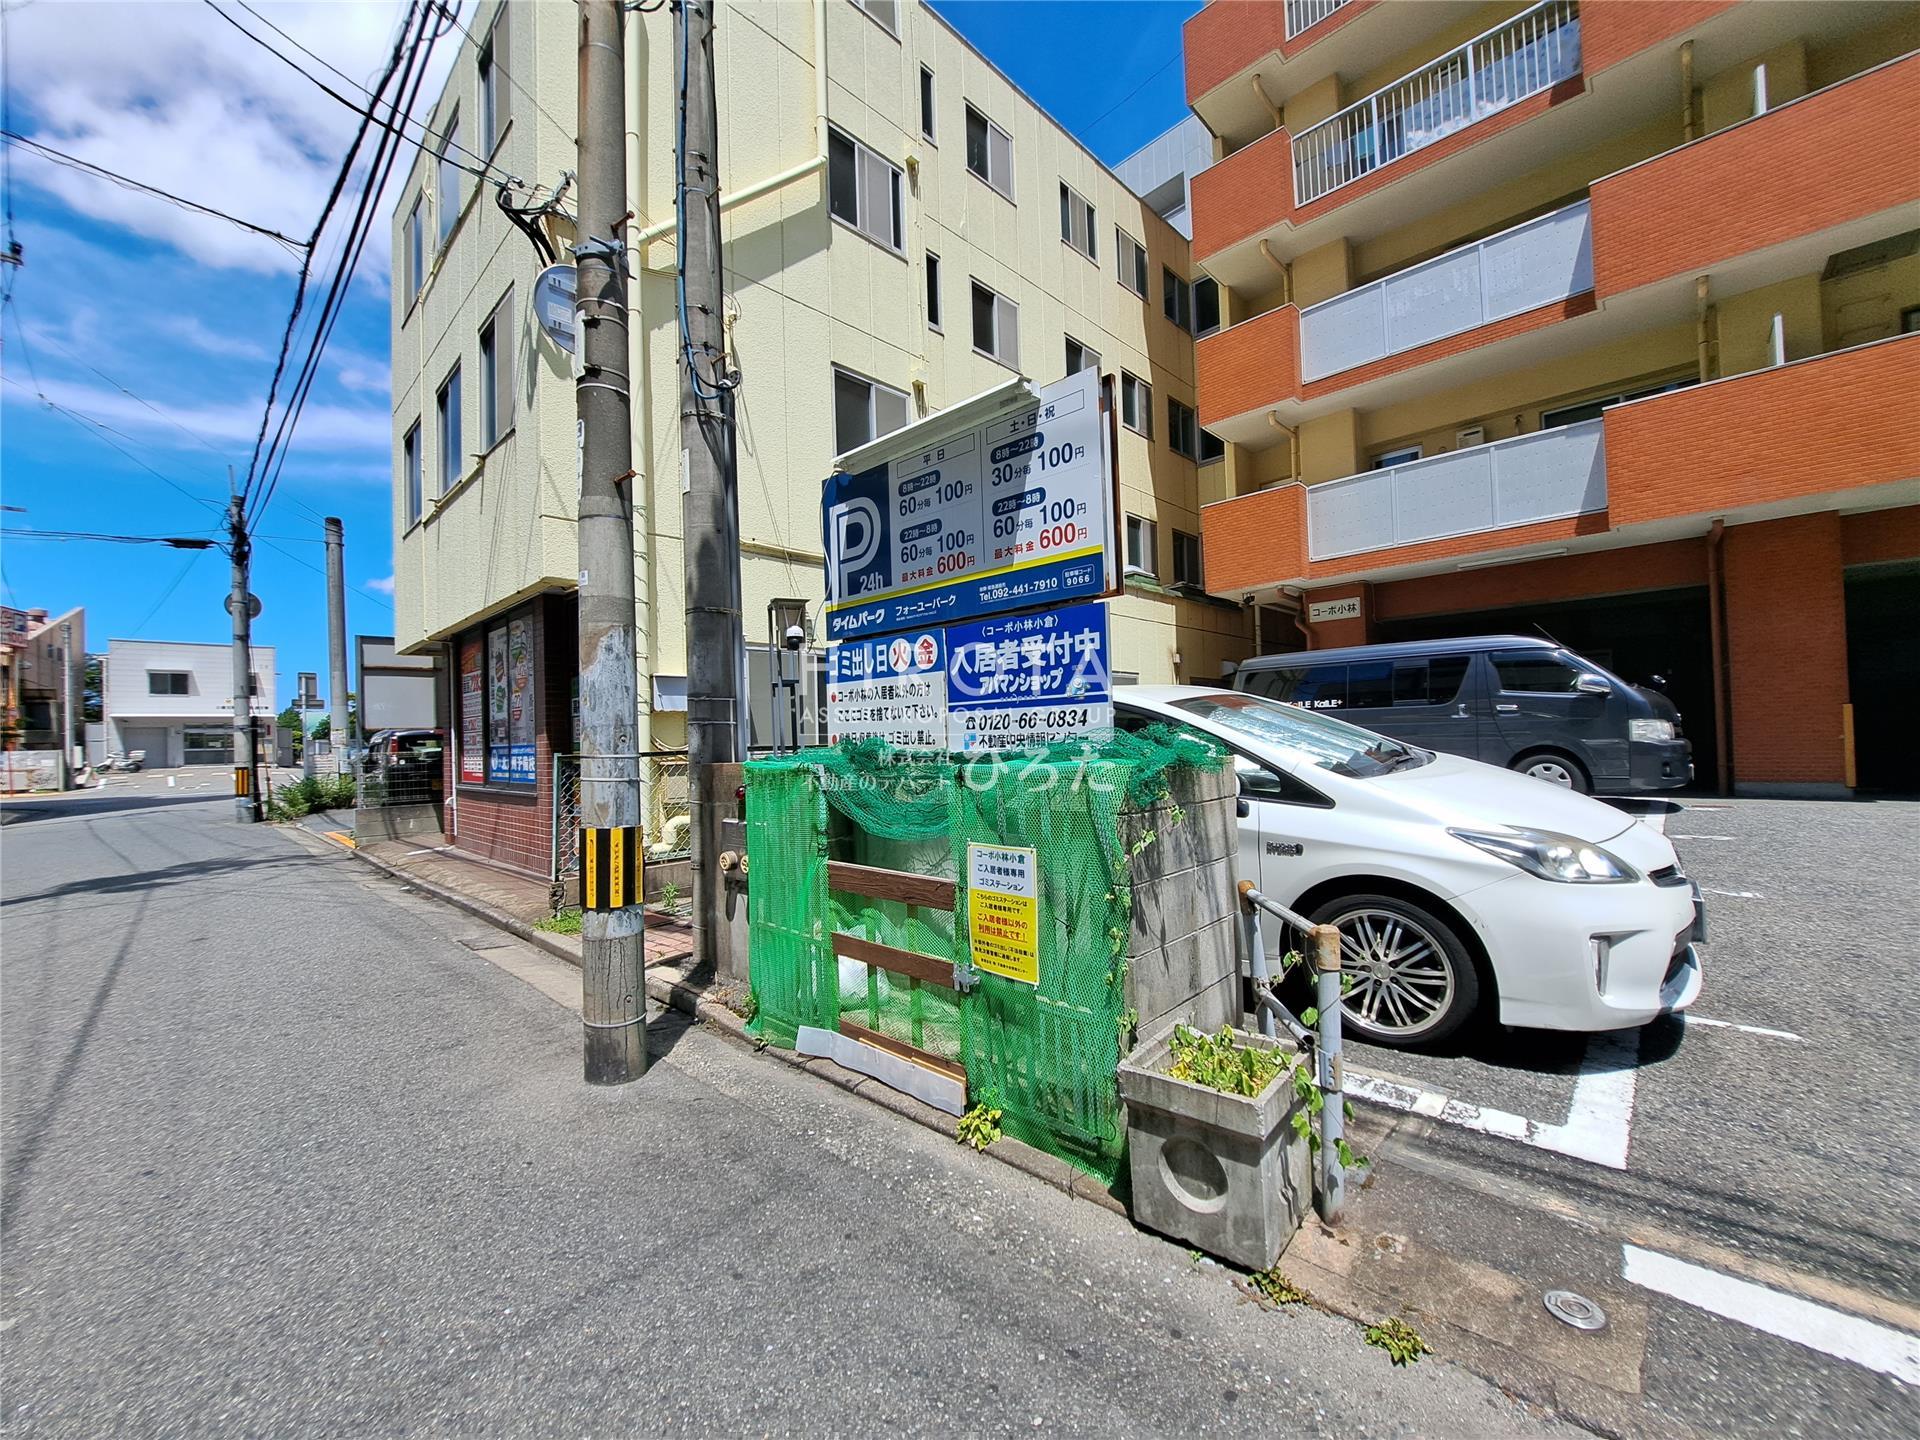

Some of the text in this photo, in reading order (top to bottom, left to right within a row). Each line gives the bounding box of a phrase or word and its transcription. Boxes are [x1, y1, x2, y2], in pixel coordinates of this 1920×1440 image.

[992, 442, 1085, 487] 30分毎 100円
[900, 480, 973, 516] 60分毎 100円
[993, 498, 1087, 538] 60分毎 100円
[901, 530, 974, 564] 60分毎 100円
[994, 522, 1088, 560] 最大料金 600円
[860, 572, 884, 593] 24h
[901, 551, 976, 583] 最大料金 600円
[1066, 574, 1090, 586] 9066
[833, 608, 885, 632] タイムパーク
[895, 594, 956, 616] フォーユーパーク
[829, 638, 934, 677] ゴミ出し日 火 金
[951, 628, 1100, 676] 入居者受付中
[979, 666, 1064, 695] アパマンショップ
